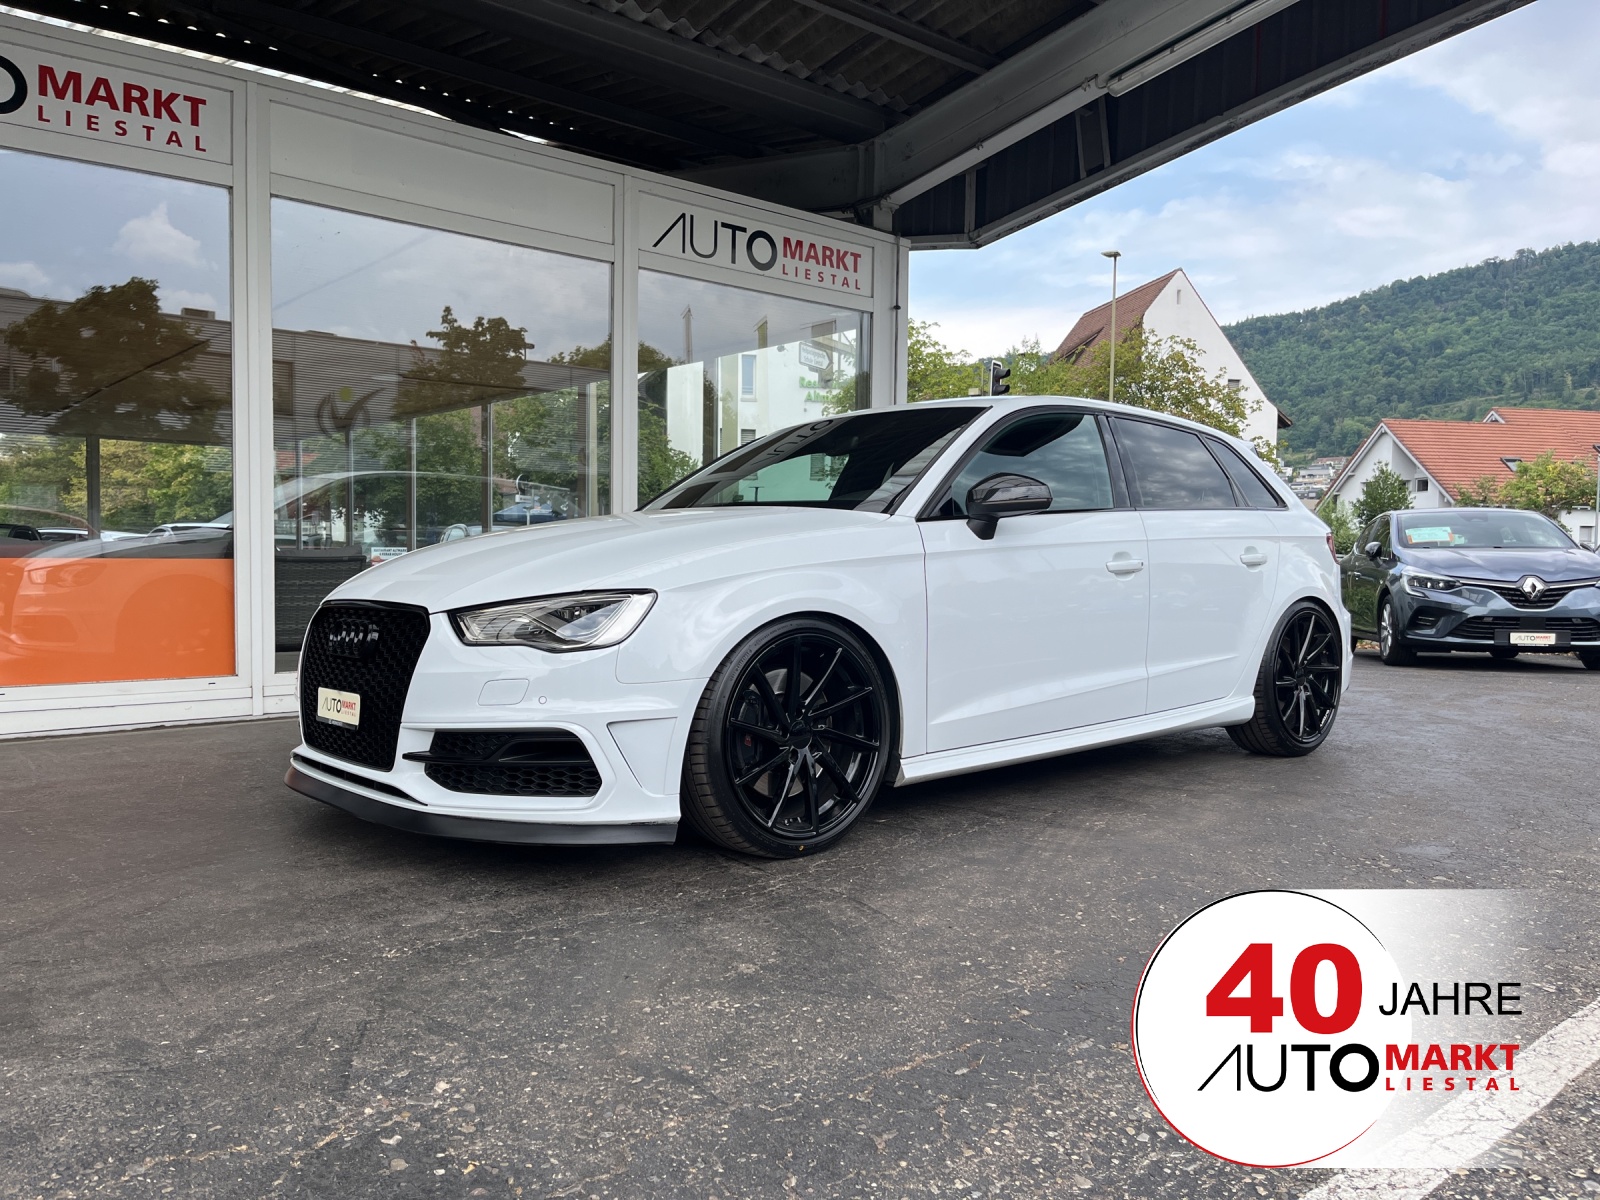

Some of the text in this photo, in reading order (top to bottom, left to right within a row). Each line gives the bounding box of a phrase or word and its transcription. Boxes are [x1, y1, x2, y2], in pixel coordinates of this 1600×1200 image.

[38, 64, 207, 127] MARKT
[38, 104, 207, 152] LIESTAL
[782, 236, 862, 273] MARKT
[782, 263, 861, 290] LIESTAL
[322, 697, 341, 713] AUTO
